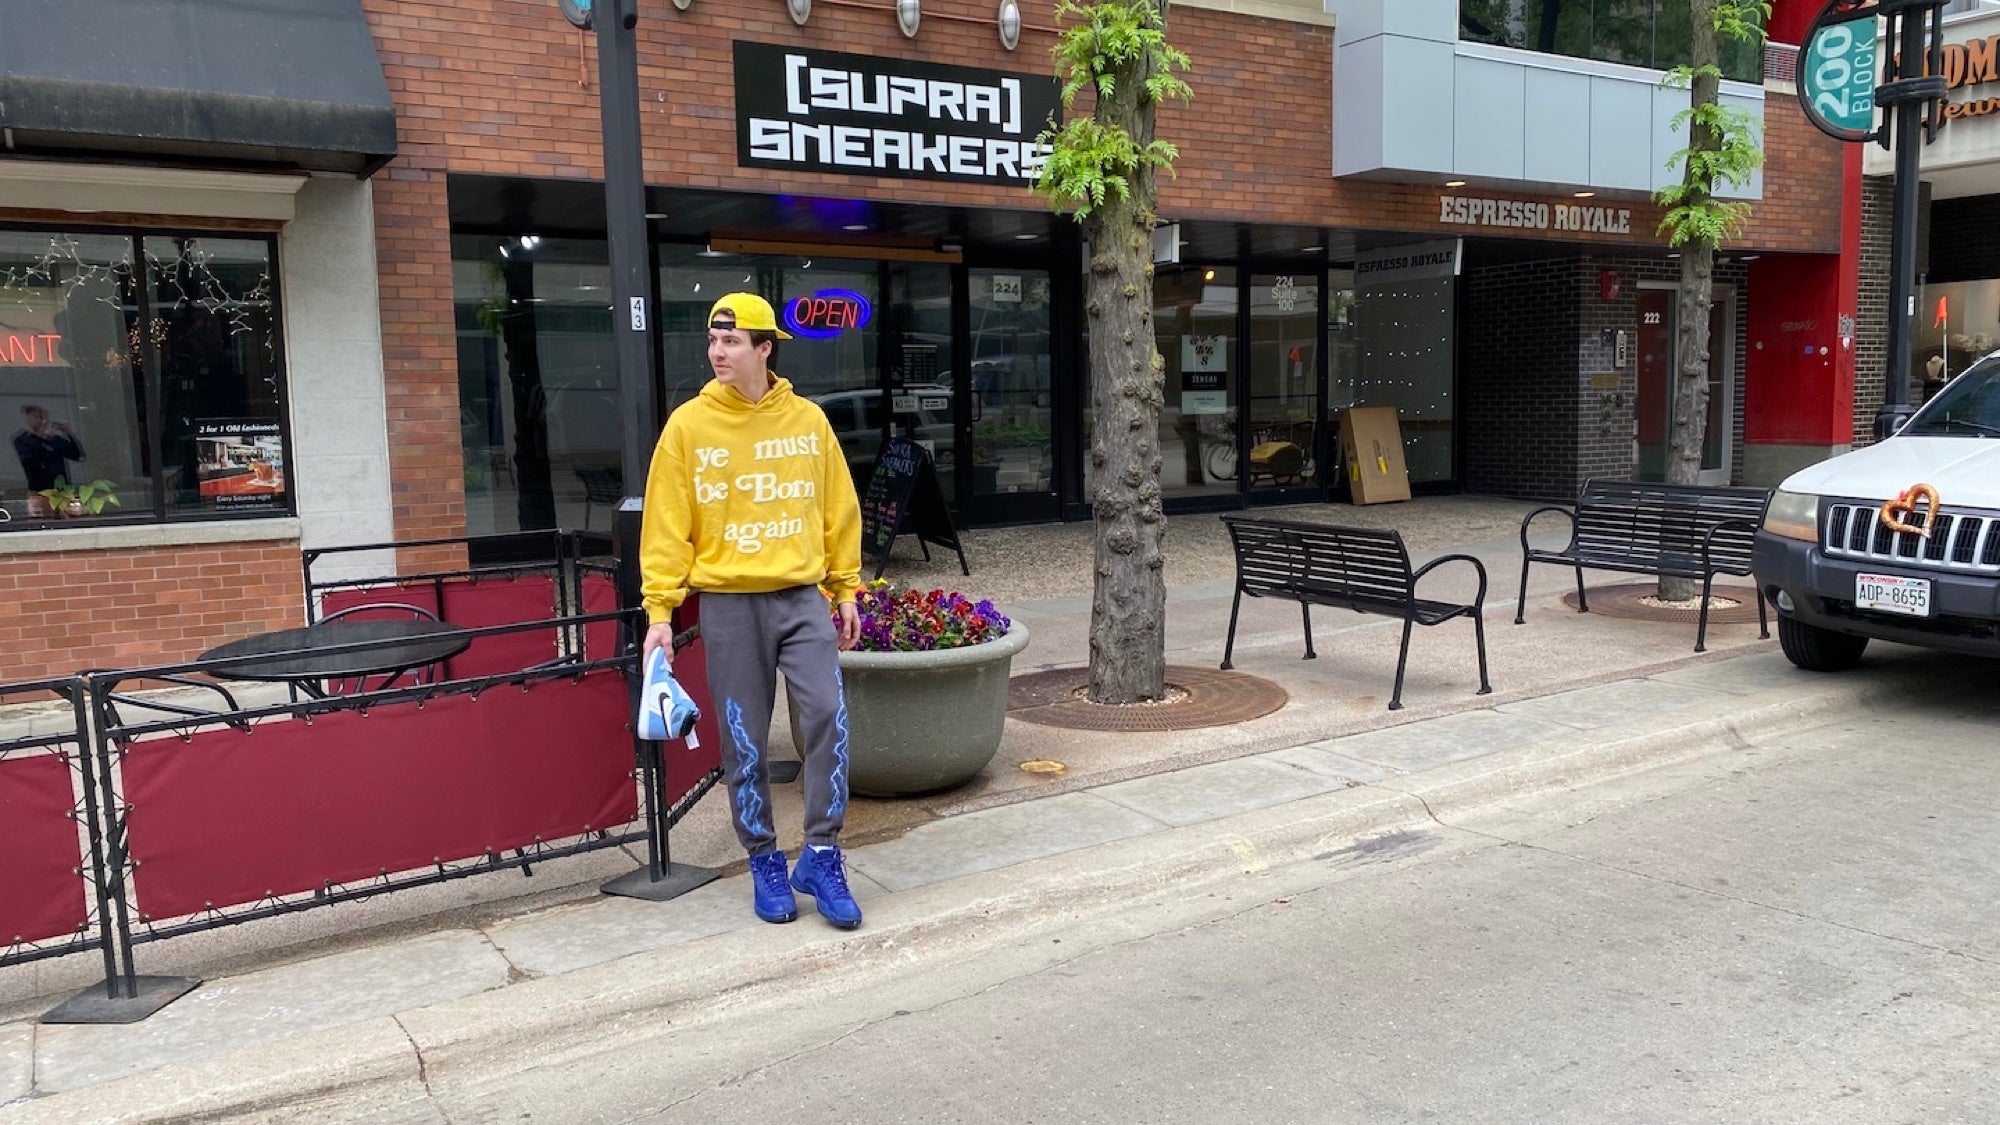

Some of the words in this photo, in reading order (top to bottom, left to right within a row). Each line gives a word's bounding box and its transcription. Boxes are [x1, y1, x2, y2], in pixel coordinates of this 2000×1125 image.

[1814, 25, 1853, 118] 200
[1852, 38, 1875, 114] BLOCK
[749, 117, 1055, 180] SNEAKERS
[1439, 195, 1549, 229] ESPRESSO
[1553, 204, 1630, 234] ROYALE
[1357, 257, 1408, 273] ESPRESSO
[1411, 251, 1452, 267] ROYALE
[995, 282, 1019, 296] 224
[1271, 287, 1298, 300] Suite
[1275, 275, 1294, 288] 224
[794, 296, 859, 328] OPEN
[1277, 299, 1294, 311] 100
[1644, 312, 1660, 324] 222
[199, 425, 205, 433] 2
[206, 424, 218, 433] for
[694, 446, 730, 472] ye
[754, 431, 820, 461] must
[693, 475, 729, 505] be
[735, 473, 815, 504] Born
[723, 511, 803, 554] again
[1859, 583, 1926, 607] ADP-8655
